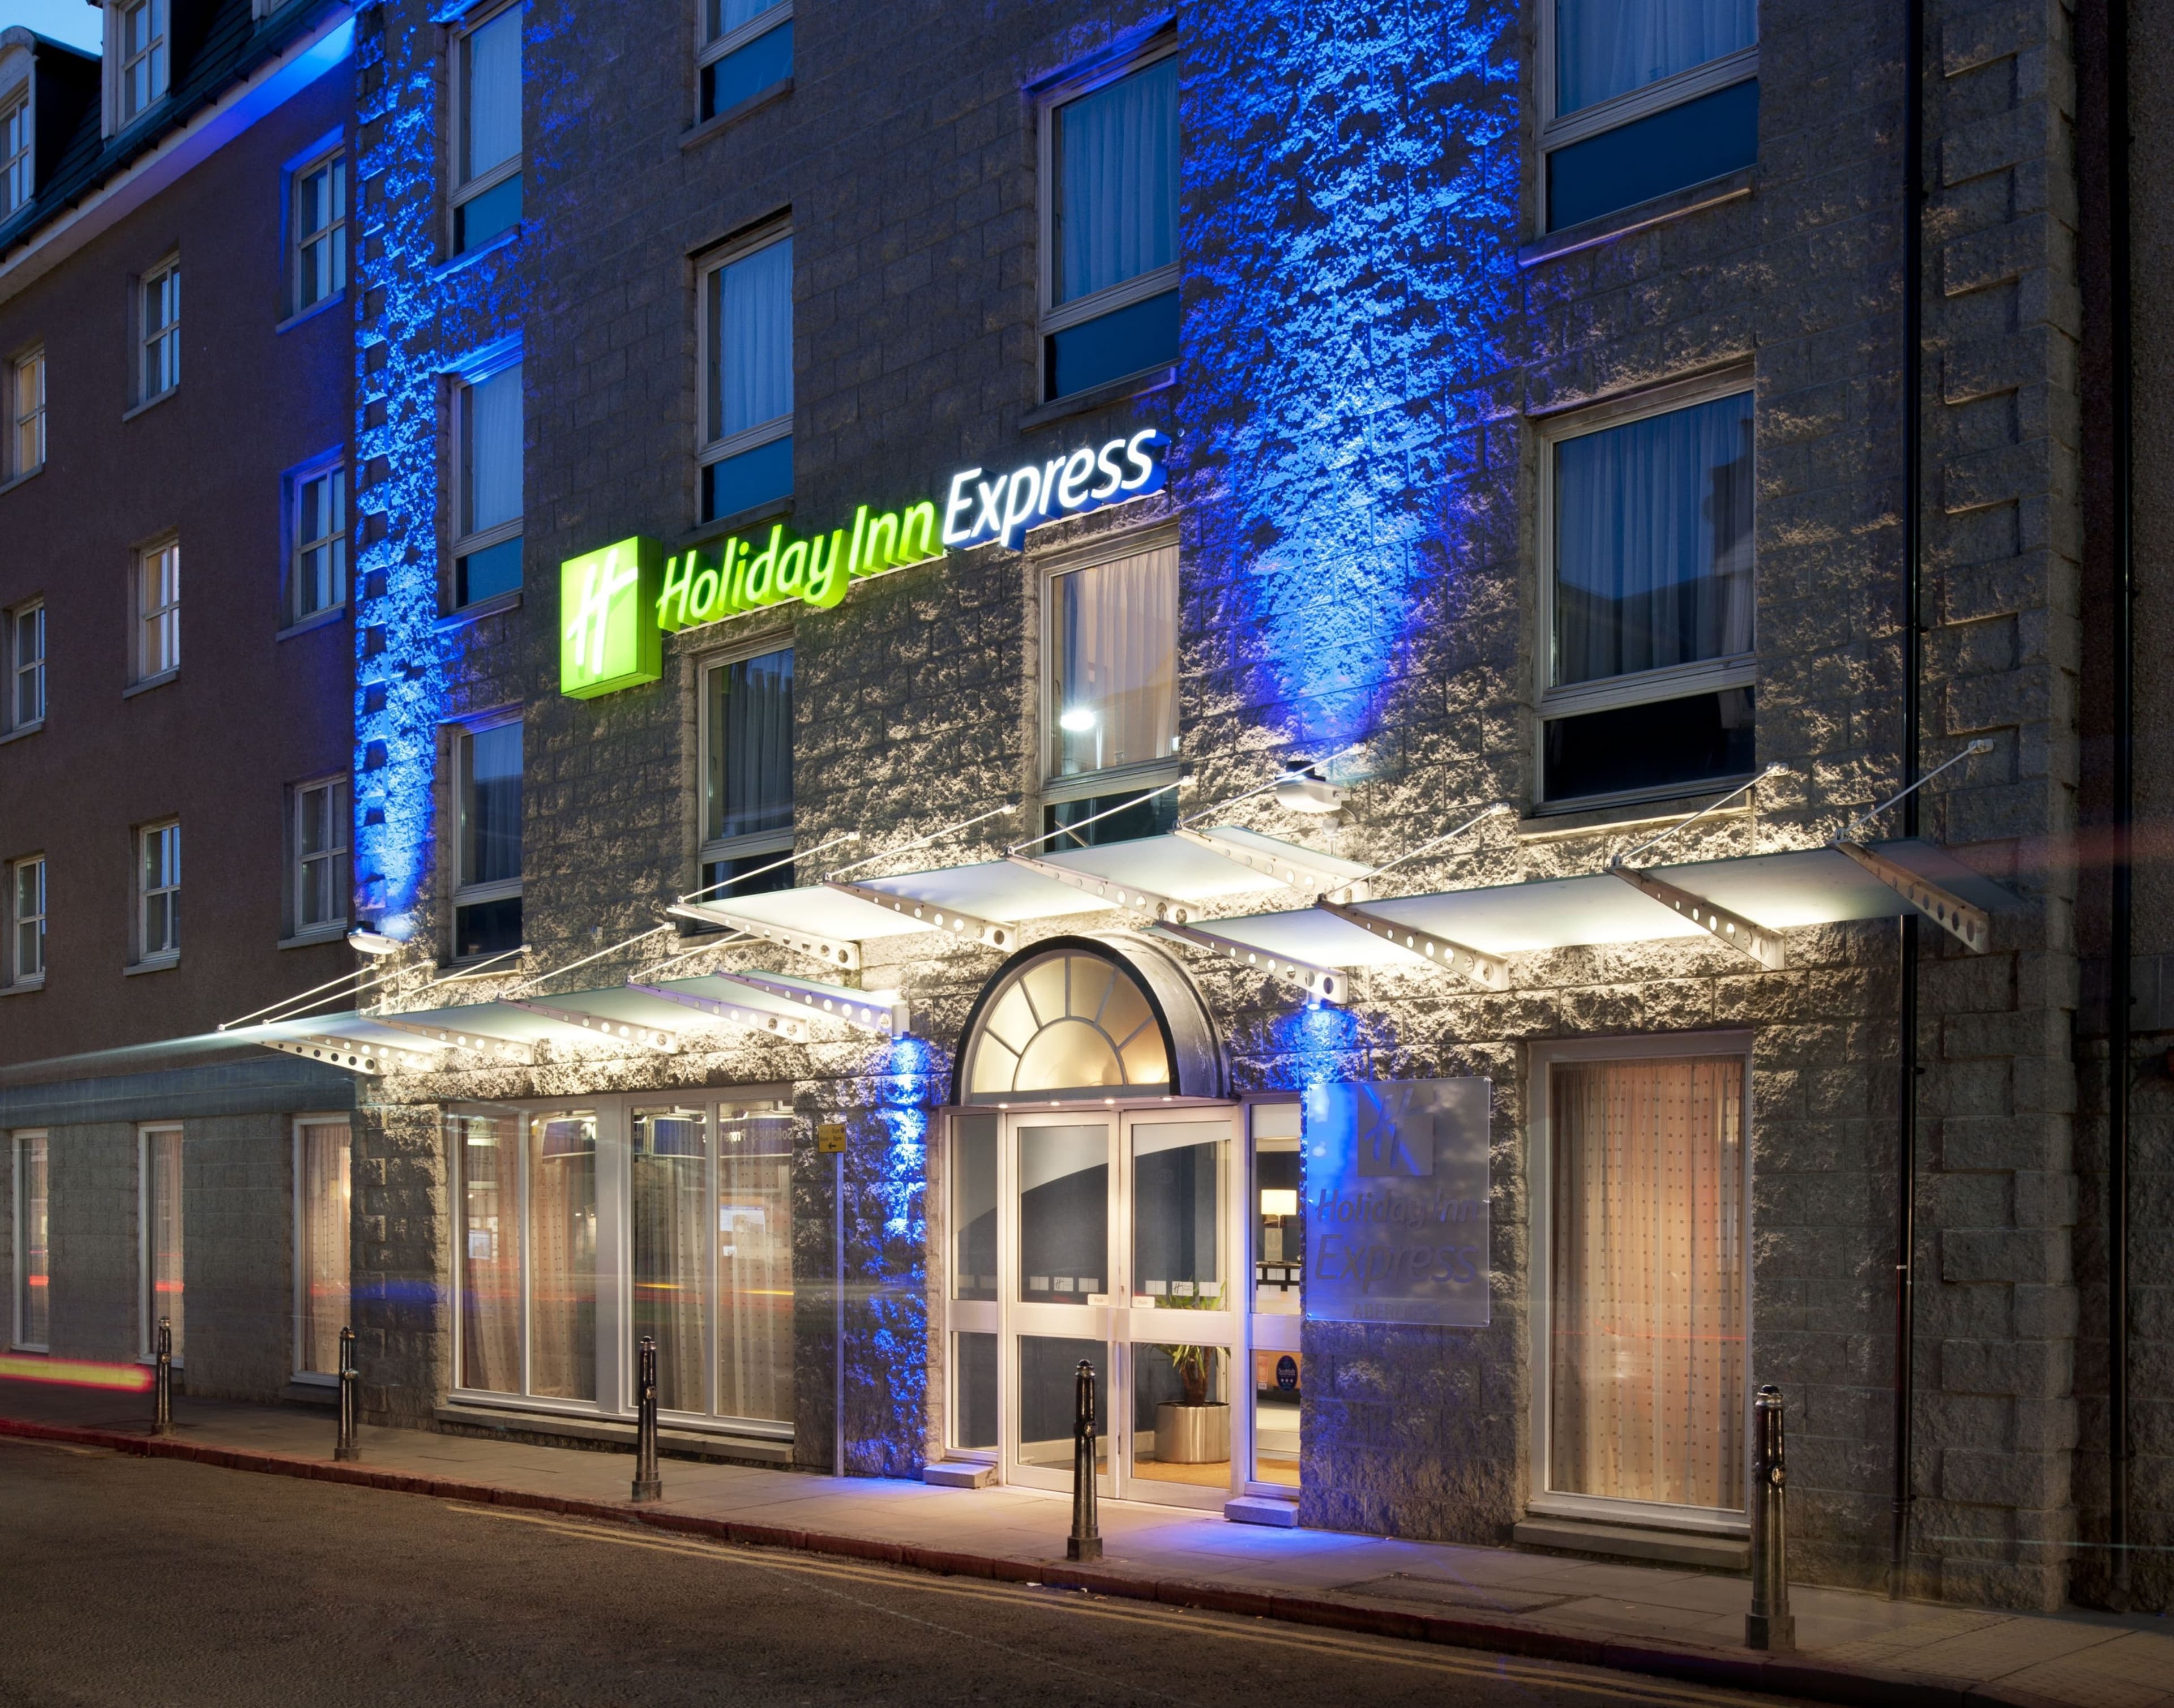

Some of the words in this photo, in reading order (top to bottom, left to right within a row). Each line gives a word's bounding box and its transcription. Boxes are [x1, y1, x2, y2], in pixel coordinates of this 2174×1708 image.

[656, 524, 846, 630] Holiday
[848, 500, 935, 573] Inn
[943, 429, 1157, 547] Express
[1315, 1188, 1426, 1230] Holiday
[1435, 1188, 1478, 1223] Inn
[1315, 1234, 1478, 1294] Express
